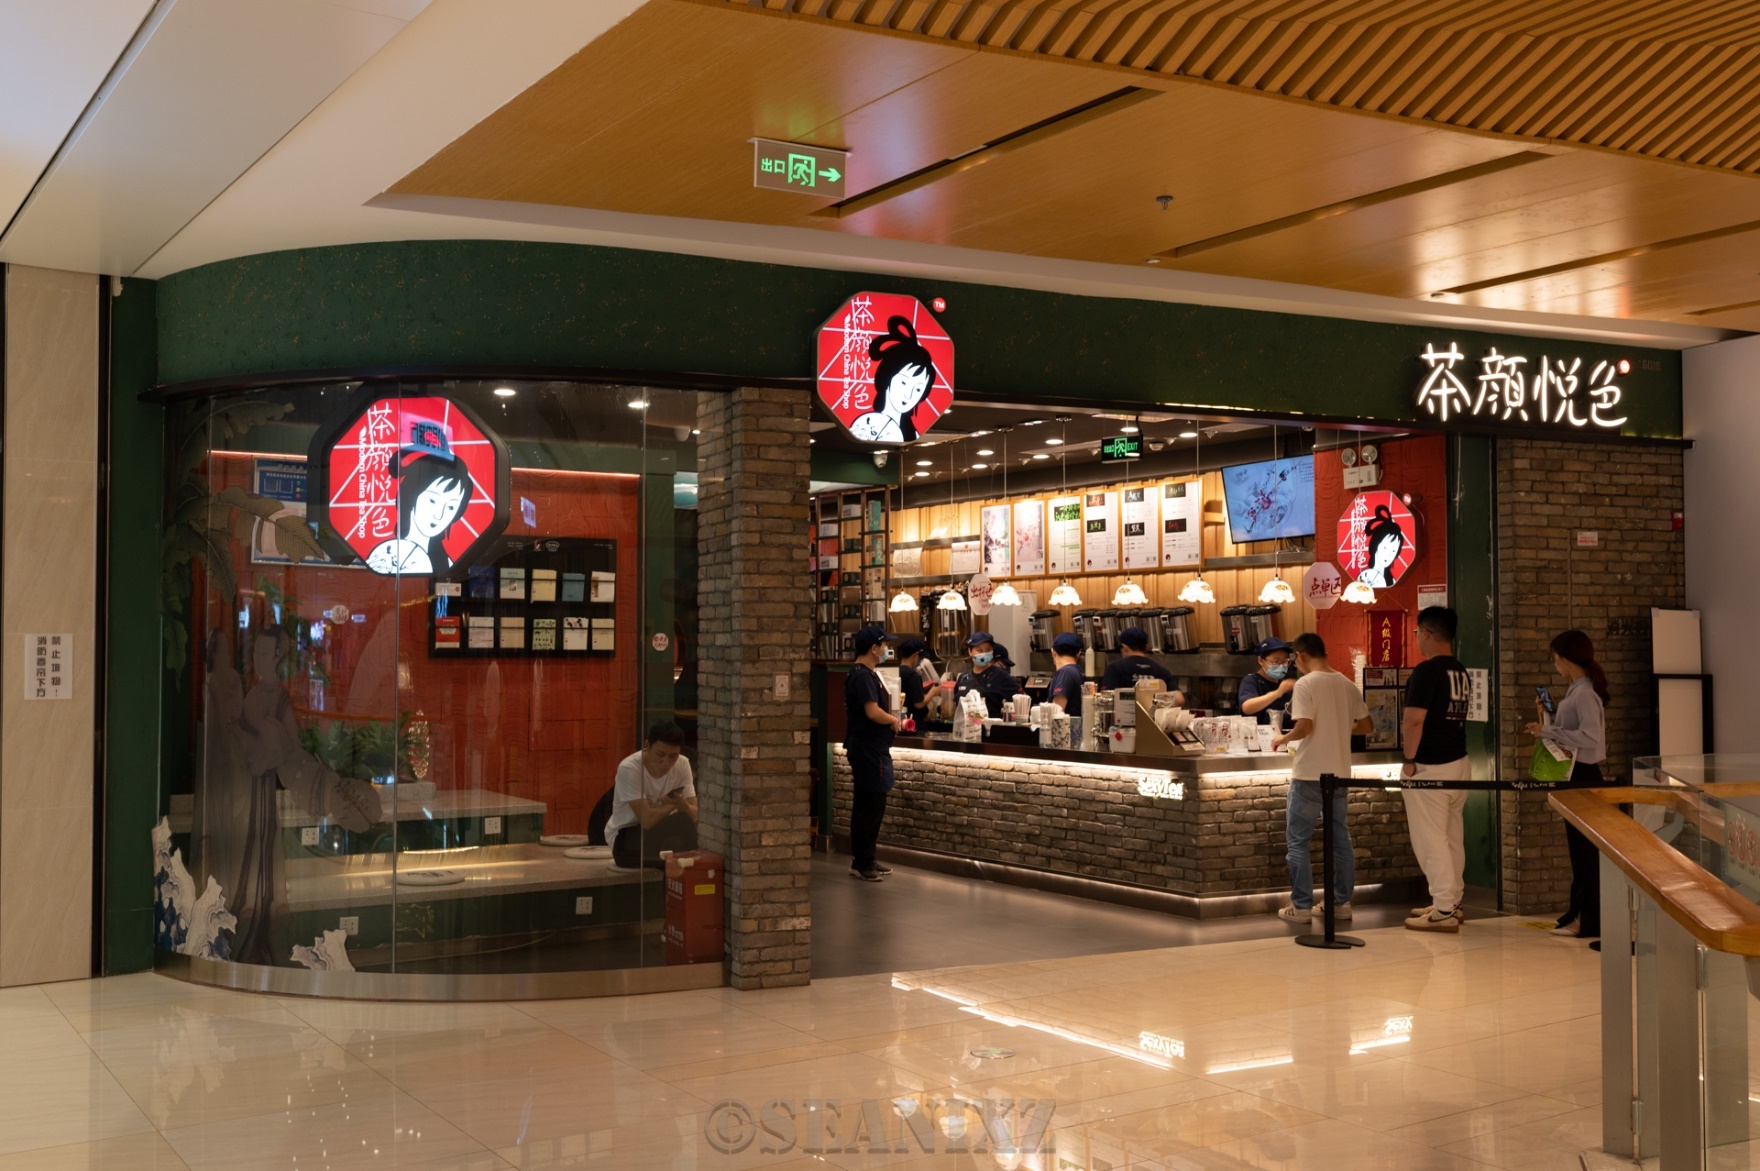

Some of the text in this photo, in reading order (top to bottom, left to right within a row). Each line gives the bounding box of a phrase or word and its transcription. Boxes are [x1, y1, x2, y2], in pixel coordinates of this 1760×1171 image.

[760, 157, 786, 175] 出口
[843, 354, 851, 376] China
[1127, 441, 1139, 452] EXIT
[359, 473, 367, 499] China
